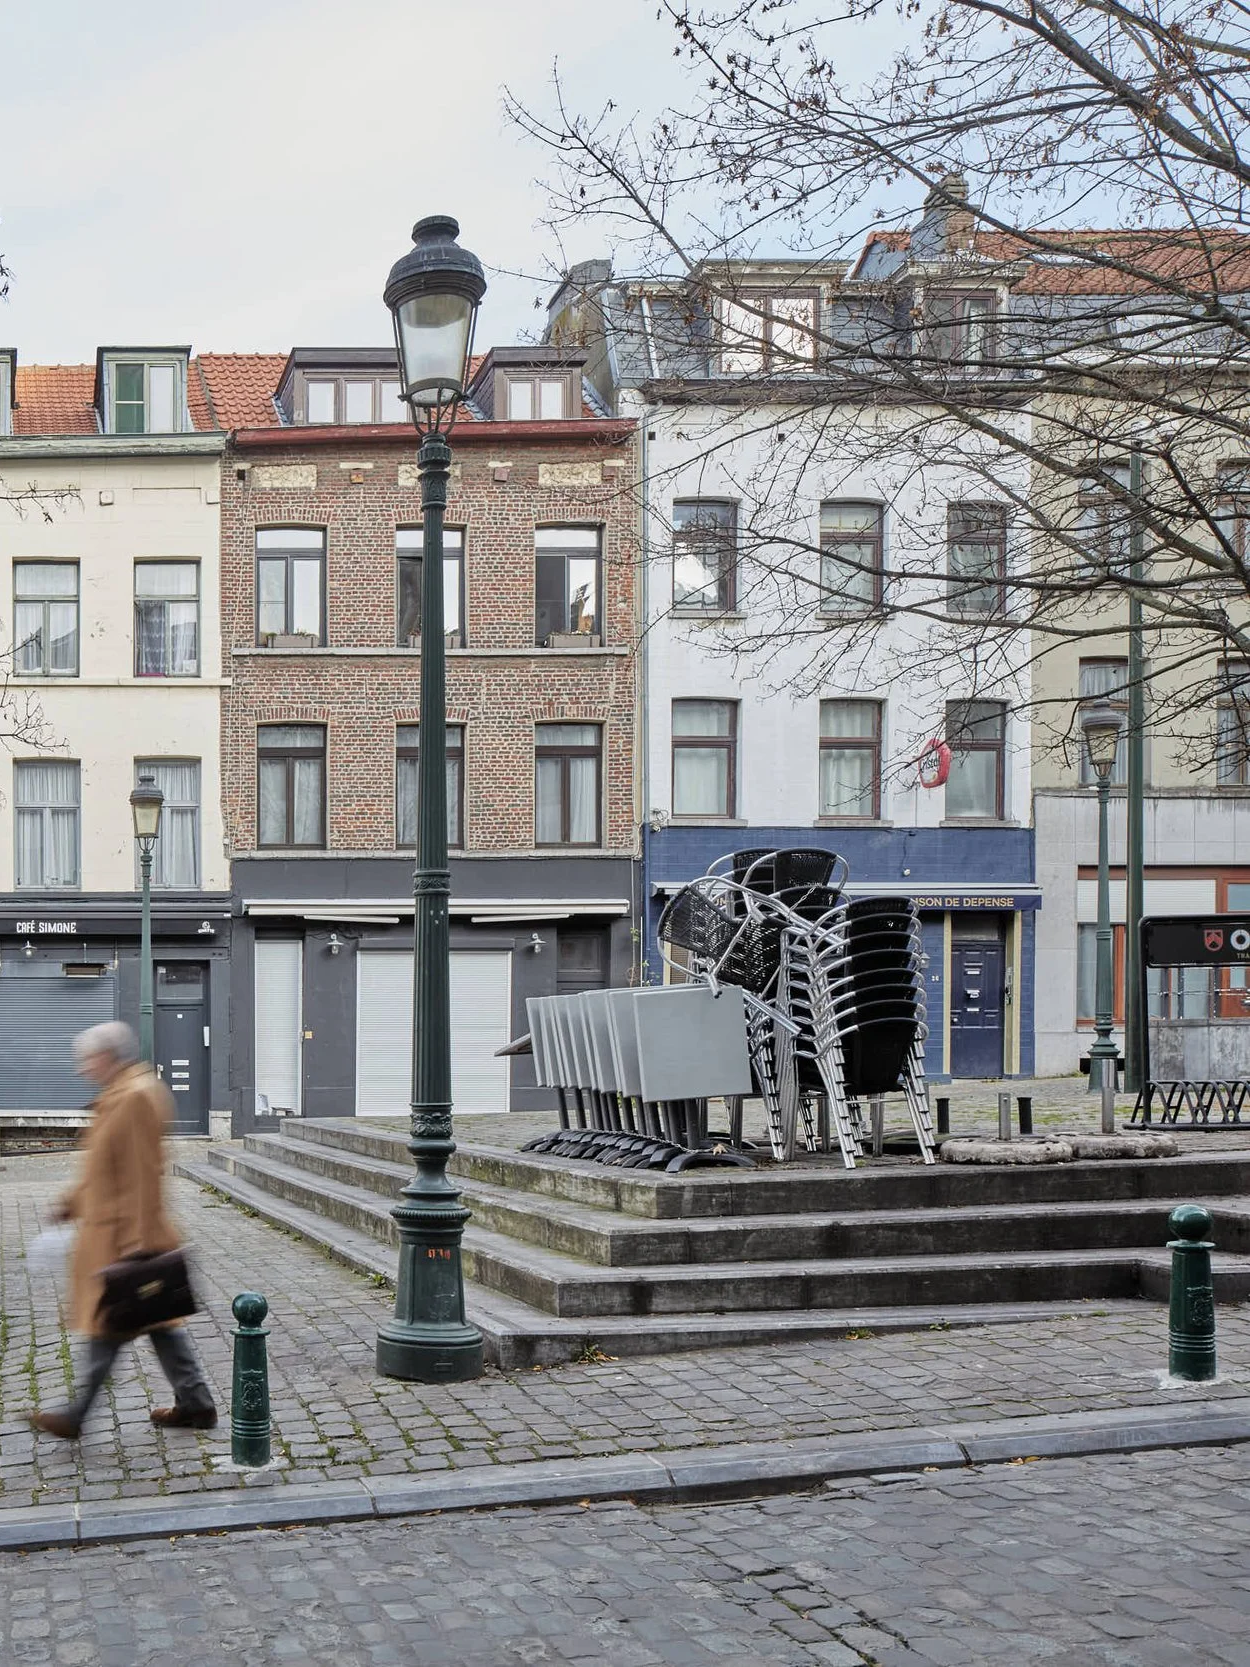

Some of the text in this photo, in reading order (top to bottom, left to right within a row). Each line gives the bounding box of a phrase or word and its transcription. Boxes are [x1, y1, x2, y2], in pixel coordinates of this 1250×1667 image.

[945, 897, 960, 907] DE
[963, 897, 1014, 907] DEPENSE
[16, 919, 77, 933] CAFÉ SIMONE
